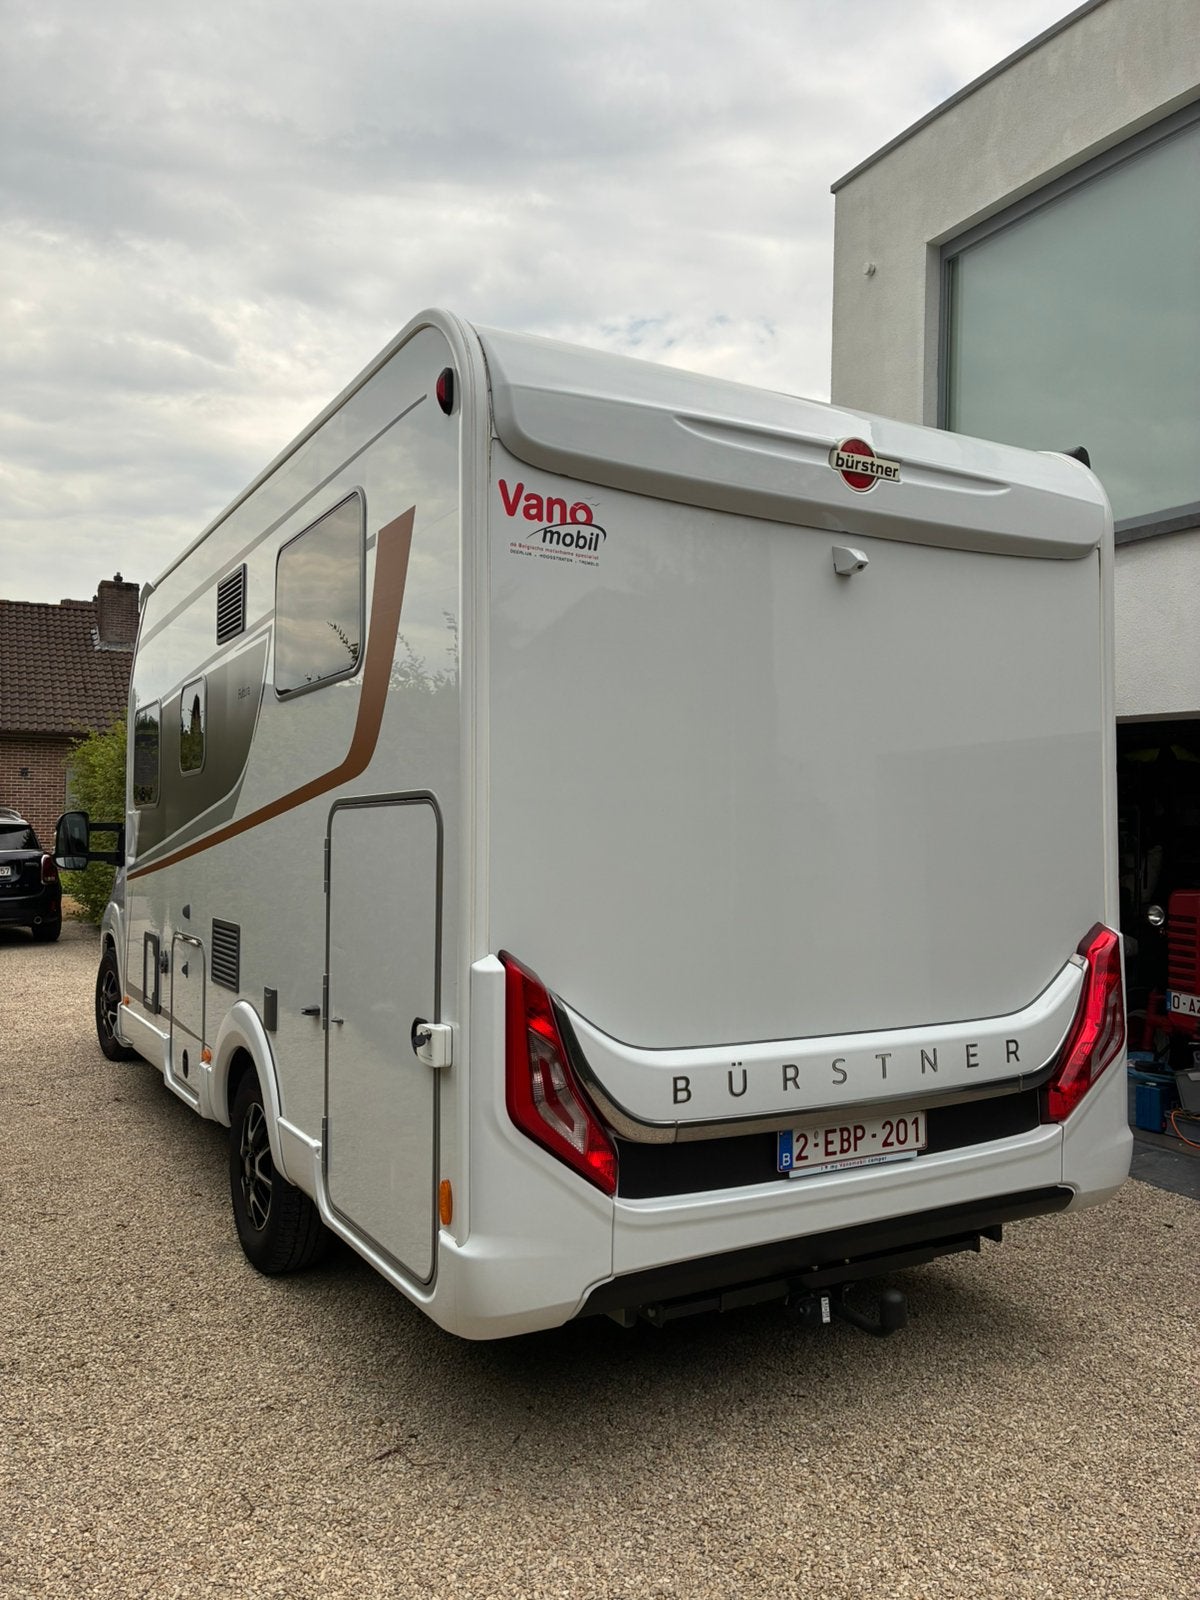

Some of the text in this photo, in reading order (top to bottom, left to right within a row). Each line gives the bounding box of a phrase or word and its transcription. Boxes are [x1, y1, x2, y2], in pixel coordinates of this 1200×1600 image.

[835, 452, 899, 478] bürstner
[498, 479, 593, 524] Vano
[542, 530, 600, 551] mobil
[672, 1039, 1021, 1104] BÜRSTNER
[782, 1153, 791, 1166] B
